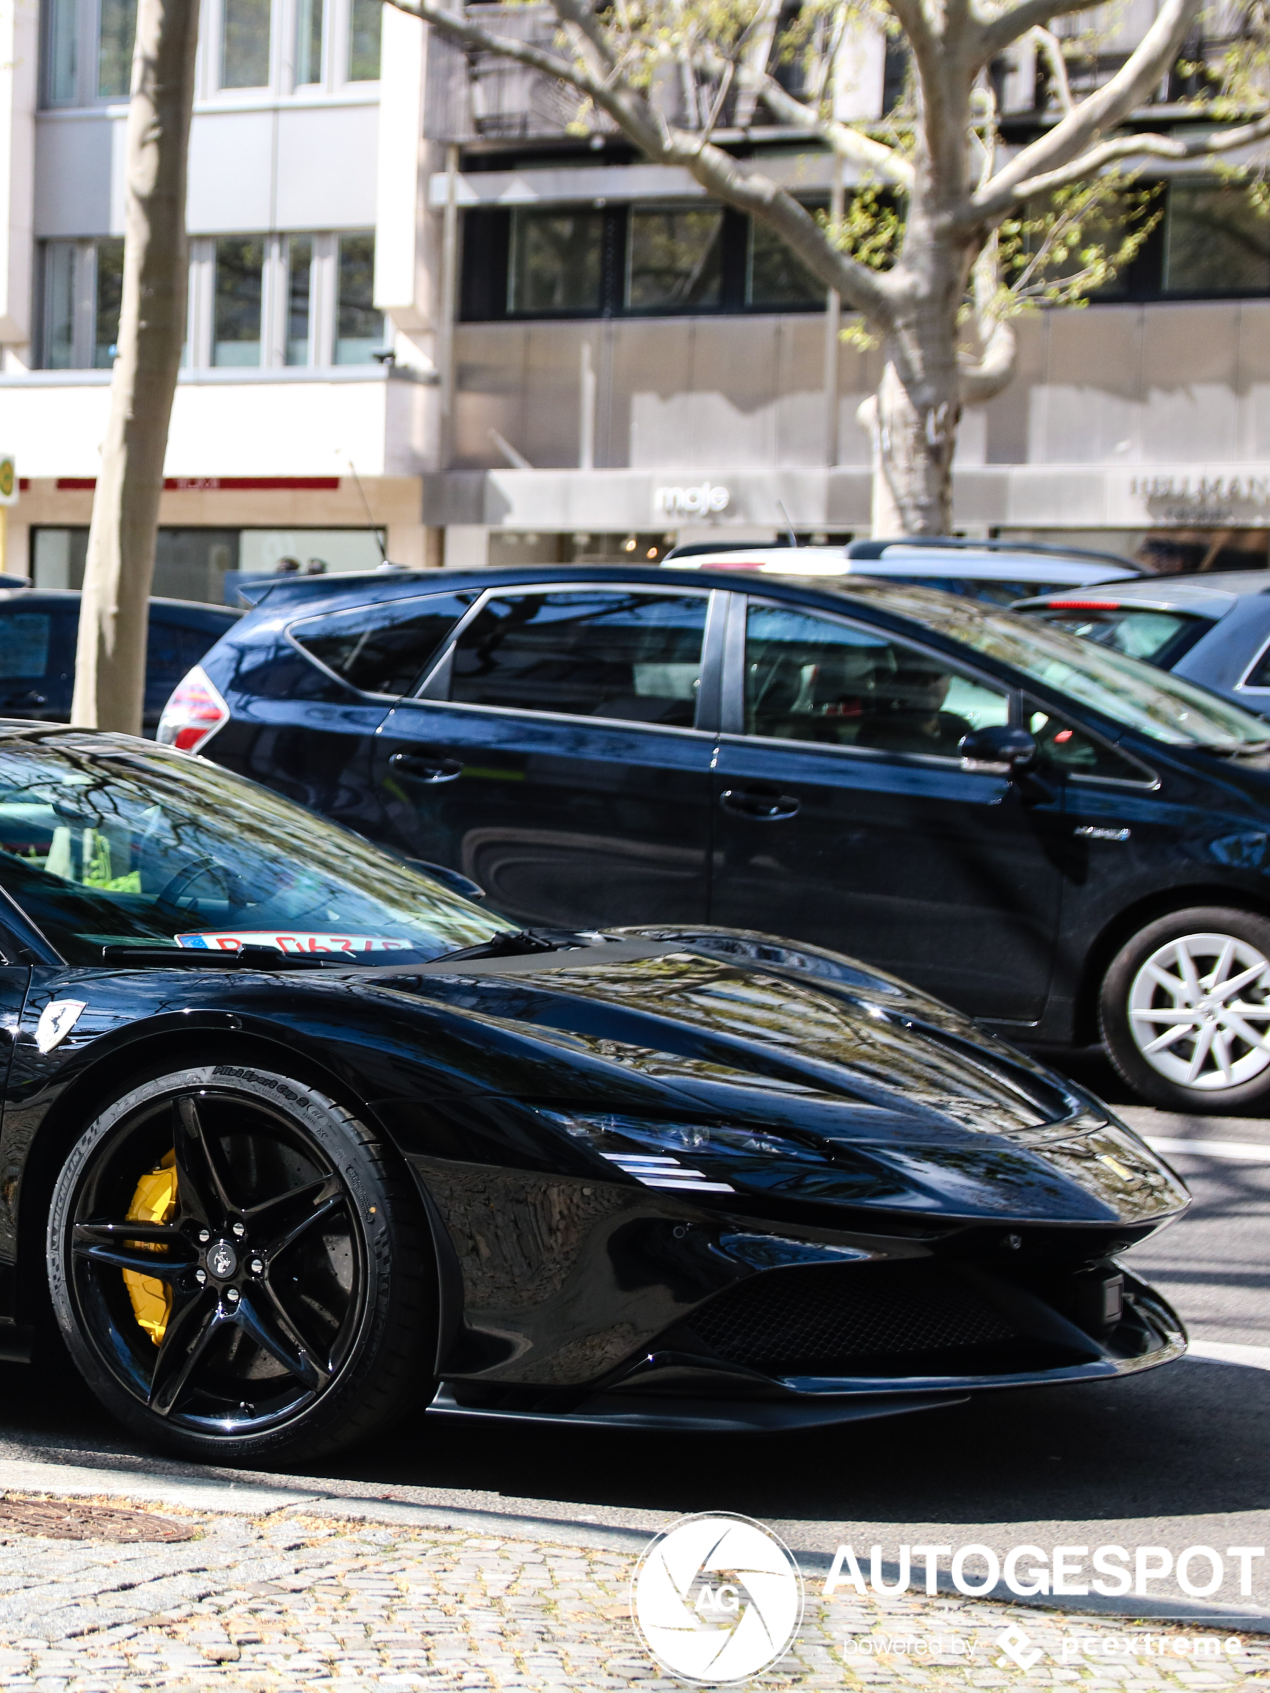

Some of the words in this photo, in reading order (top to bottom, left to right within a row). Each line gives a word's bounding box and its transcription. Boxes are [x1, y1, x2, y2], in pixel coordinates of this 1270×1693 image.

[655, 481, 730, 516] maje
[212, 1065, 245, 1078] Pilot
[242, 1070, 279, 1090] Sport
[276, 1083, 299, 1103] Cup
[296, 1096, 310, 1108] 2
[53, 1147, 82, 1230] MICHELIN
